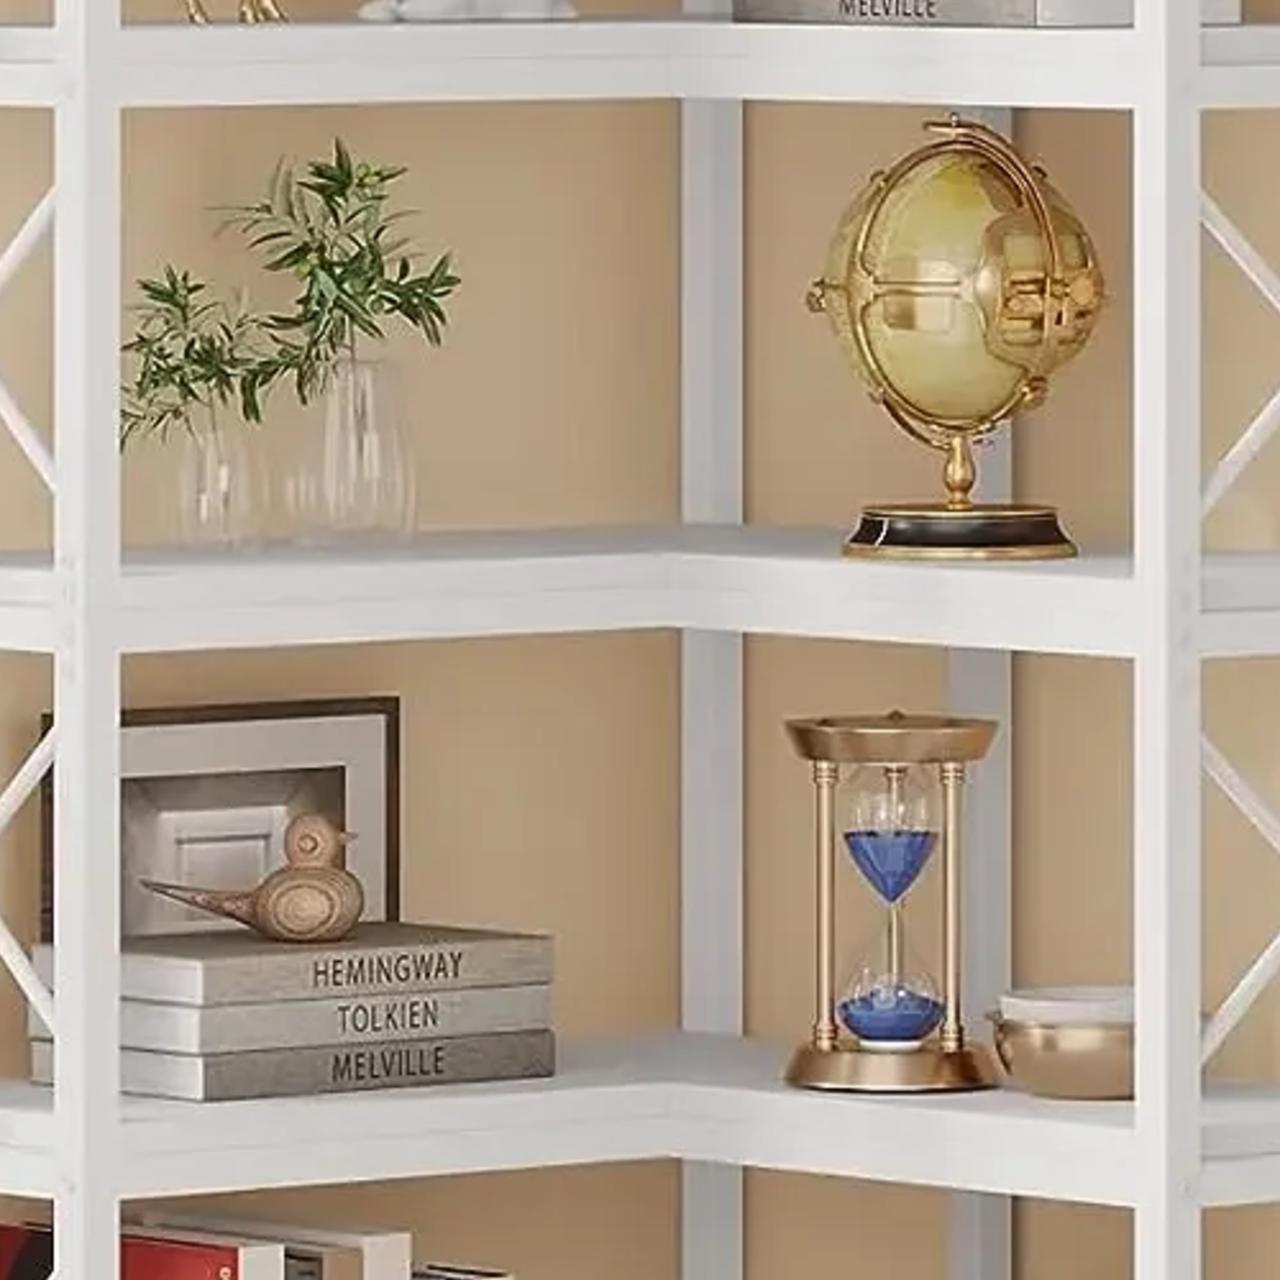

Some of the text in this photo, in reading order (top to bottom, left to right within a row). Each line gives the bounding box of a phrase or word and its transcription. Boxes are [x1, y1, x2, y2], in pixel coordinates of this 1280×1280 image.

[313, 950, 464, 988] HEMINGWAY
[337, 999, 440, 1033] TOLKIEN
[331, 1046, 446, 1083] MELVILLE
